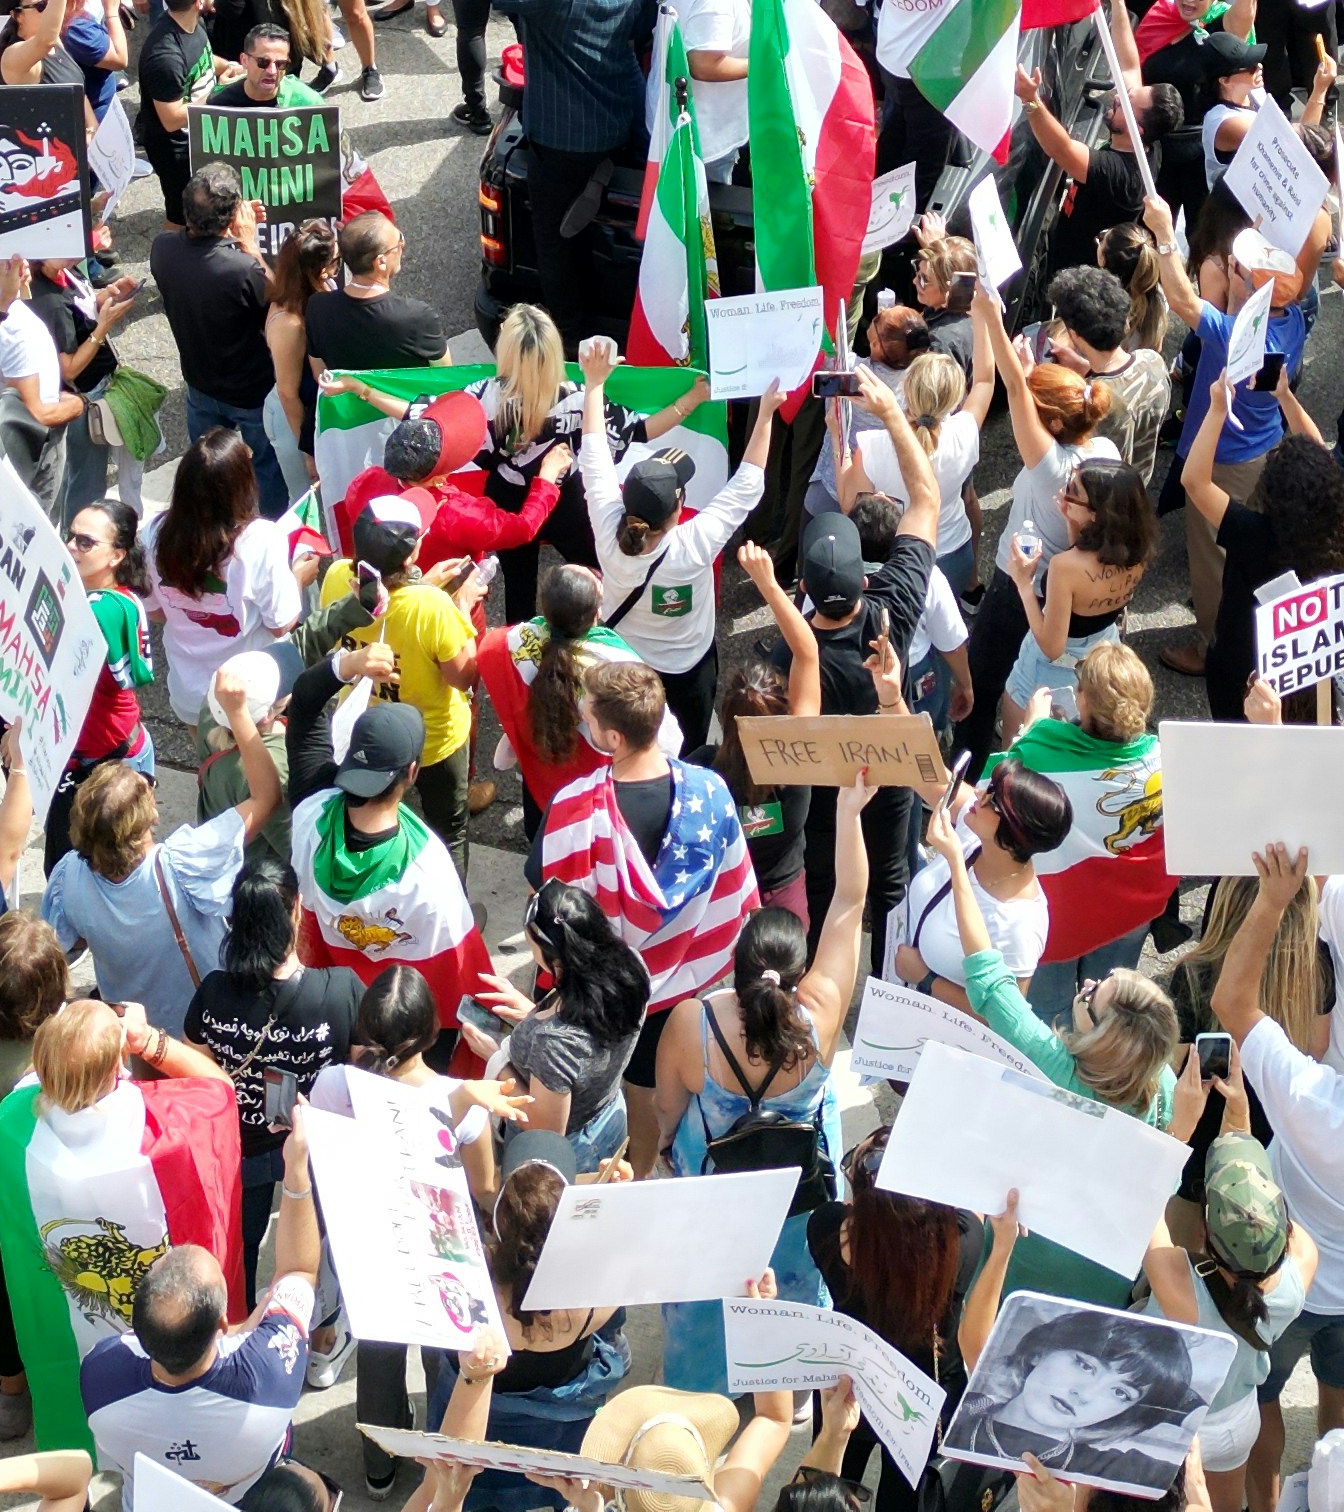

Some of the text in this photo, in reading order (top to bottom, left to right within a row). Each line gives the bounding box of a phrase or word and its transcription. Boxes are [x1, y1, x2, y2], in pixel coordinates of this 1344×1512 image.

[199, 114, 330, 160] MAHSA
[1270, 135, 1300, 180] Prosecute
[240, 163, 315, 208] MINI
[1250, 182, 1277, 223] humanity
[1270, 188, 1295, 222] against
[1275, 595, 1323, 633] NO
[759, 738, 911, 768] FREE IRAN!
[854, 1056, 913, 1075] Justice for
[729, 1304, 937, 1412] Woman. Life. Freedom.
[732, 1375, 779, 1389] Justice
[781, 1374, 799, 1387] for
